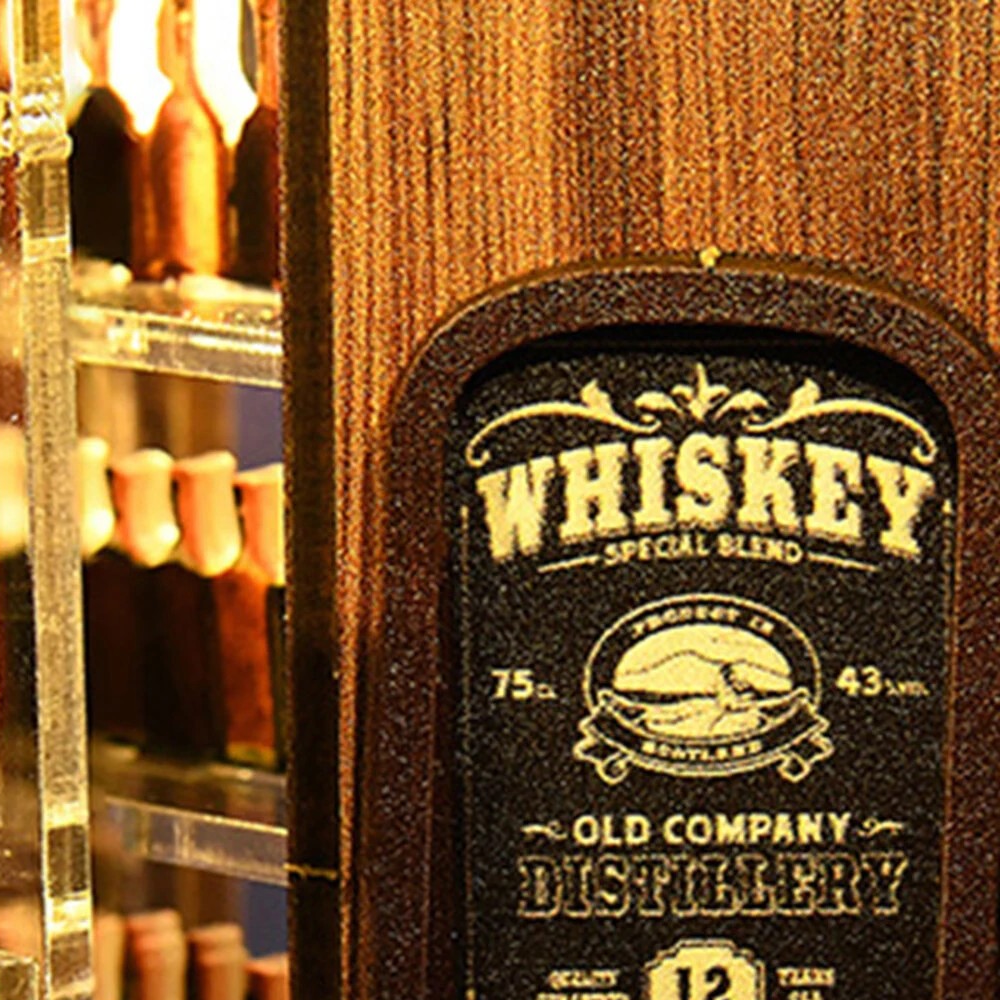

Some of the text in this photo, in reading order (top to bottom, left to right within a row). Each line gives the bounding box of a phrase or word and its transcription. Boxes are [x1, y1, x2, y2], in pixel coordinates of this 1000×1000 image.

[477, 432, 936, 561] WHISKEY
[604, 533, 803, 566] SPECIAL BLEND
[573, 812, 851, 846] OLD COMPANY
[517, 852, 909, 918] DISTILLERY
